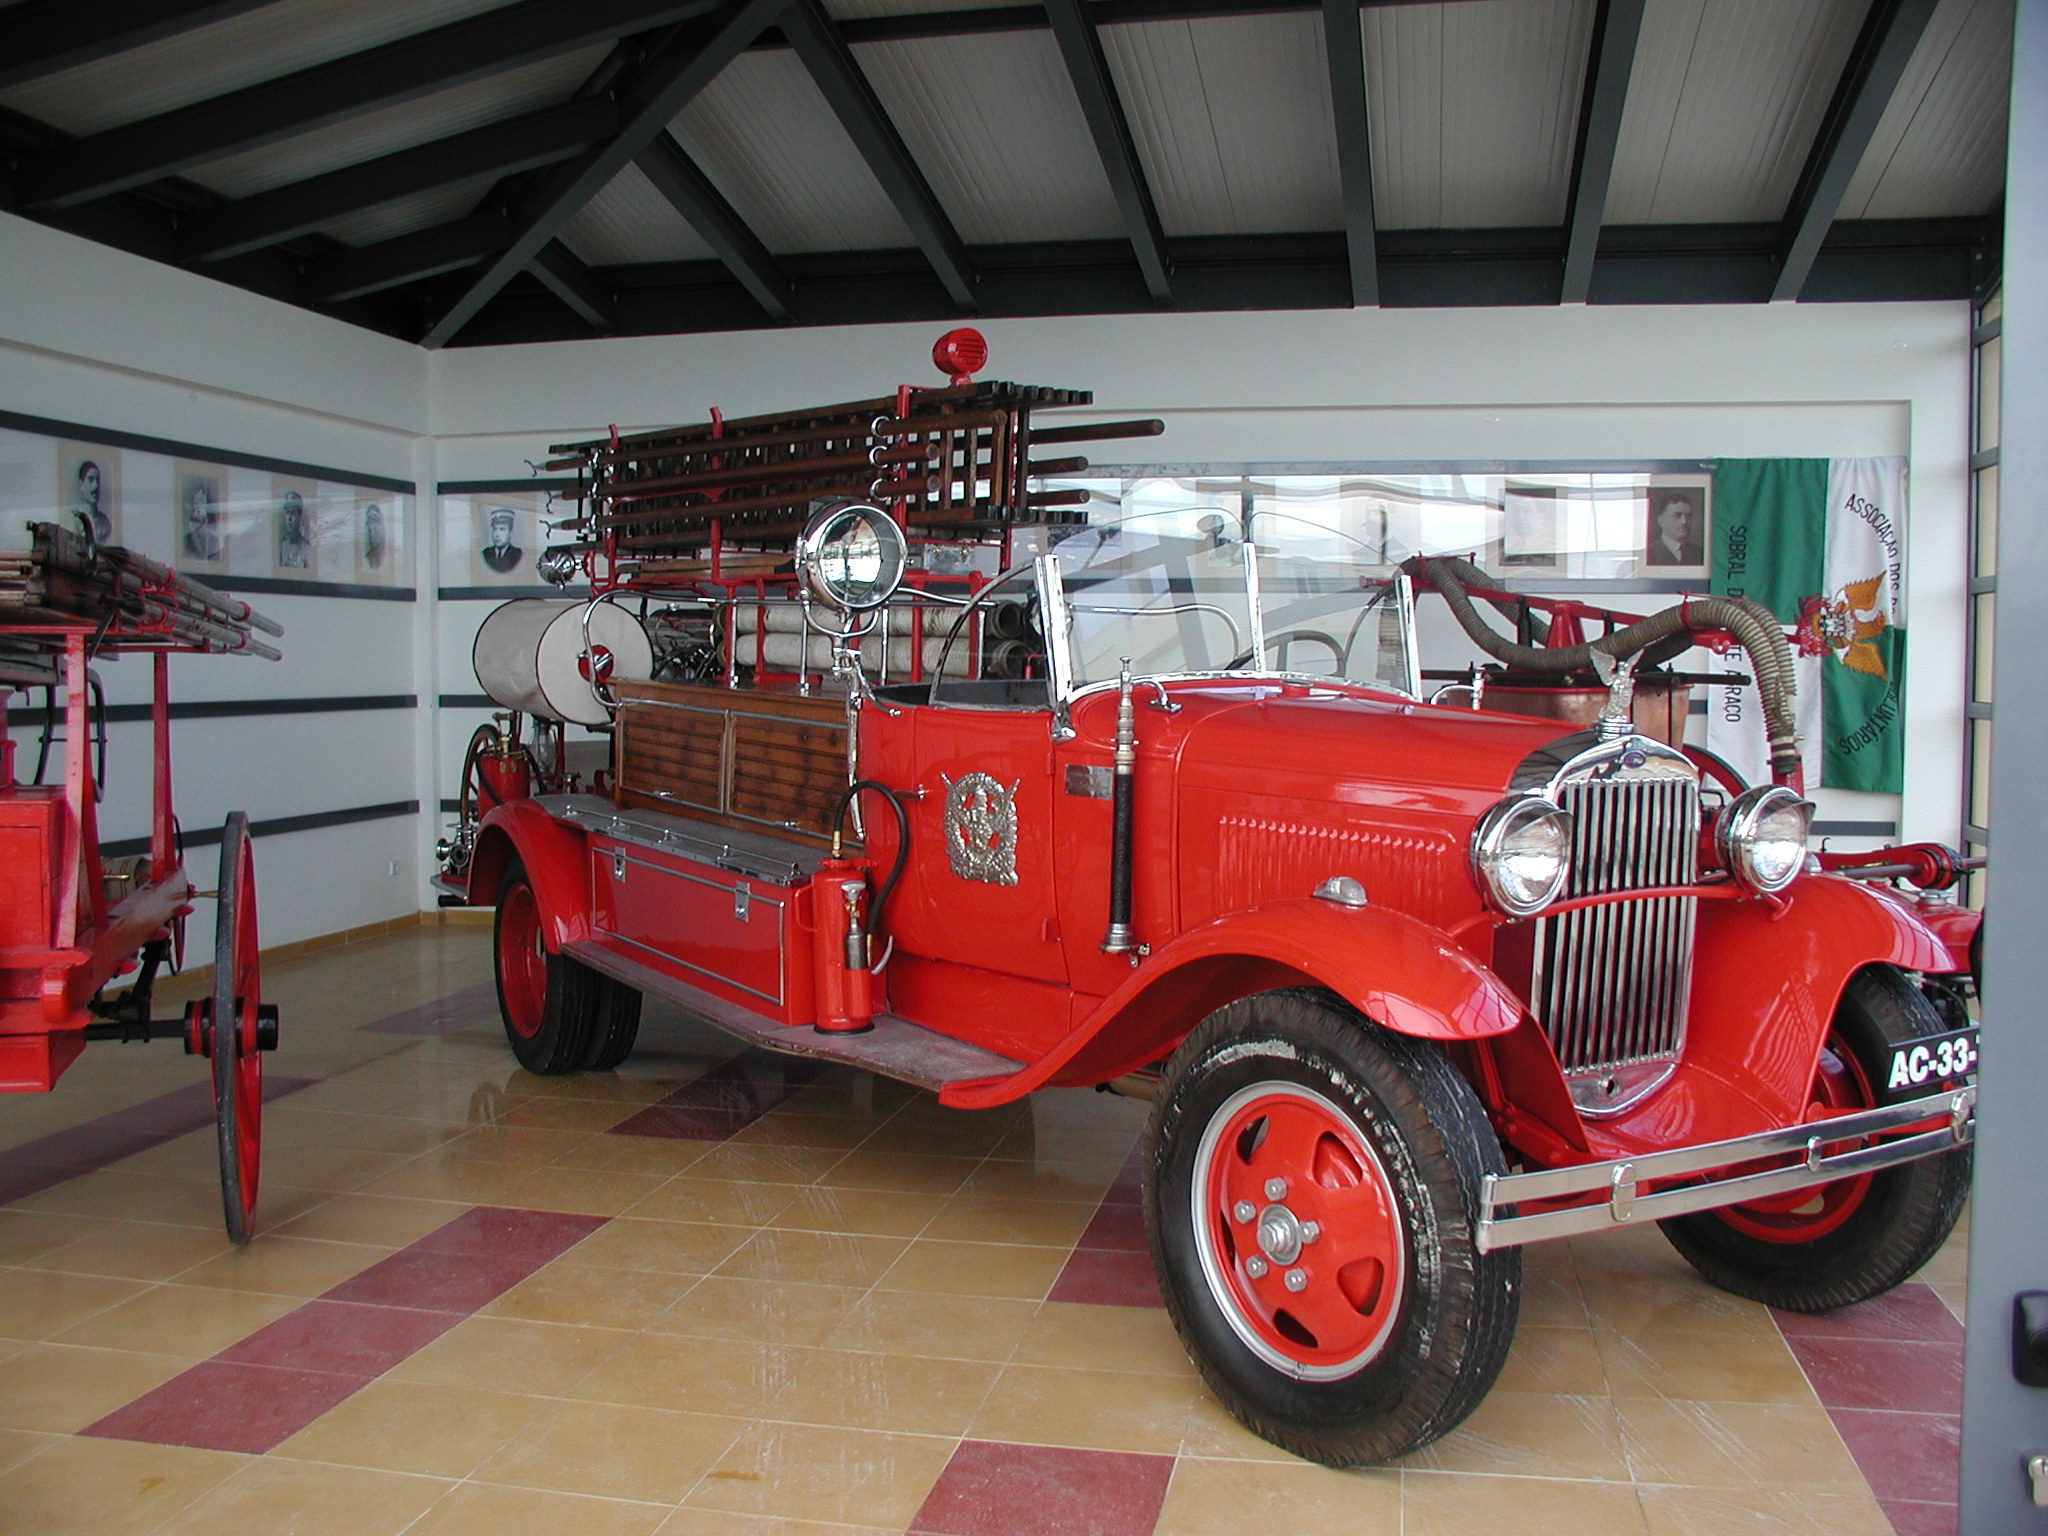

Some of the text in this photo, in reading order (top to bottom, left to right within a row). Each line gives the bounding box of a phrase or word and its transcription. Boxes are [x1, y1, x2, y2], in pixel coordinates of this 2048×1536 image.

[1727, 525, 1748, 580] SOBRAL
[1722, 669, 1742, 722] ARAÇO
[1888, 1034, 1980, 1089] AC-33-
